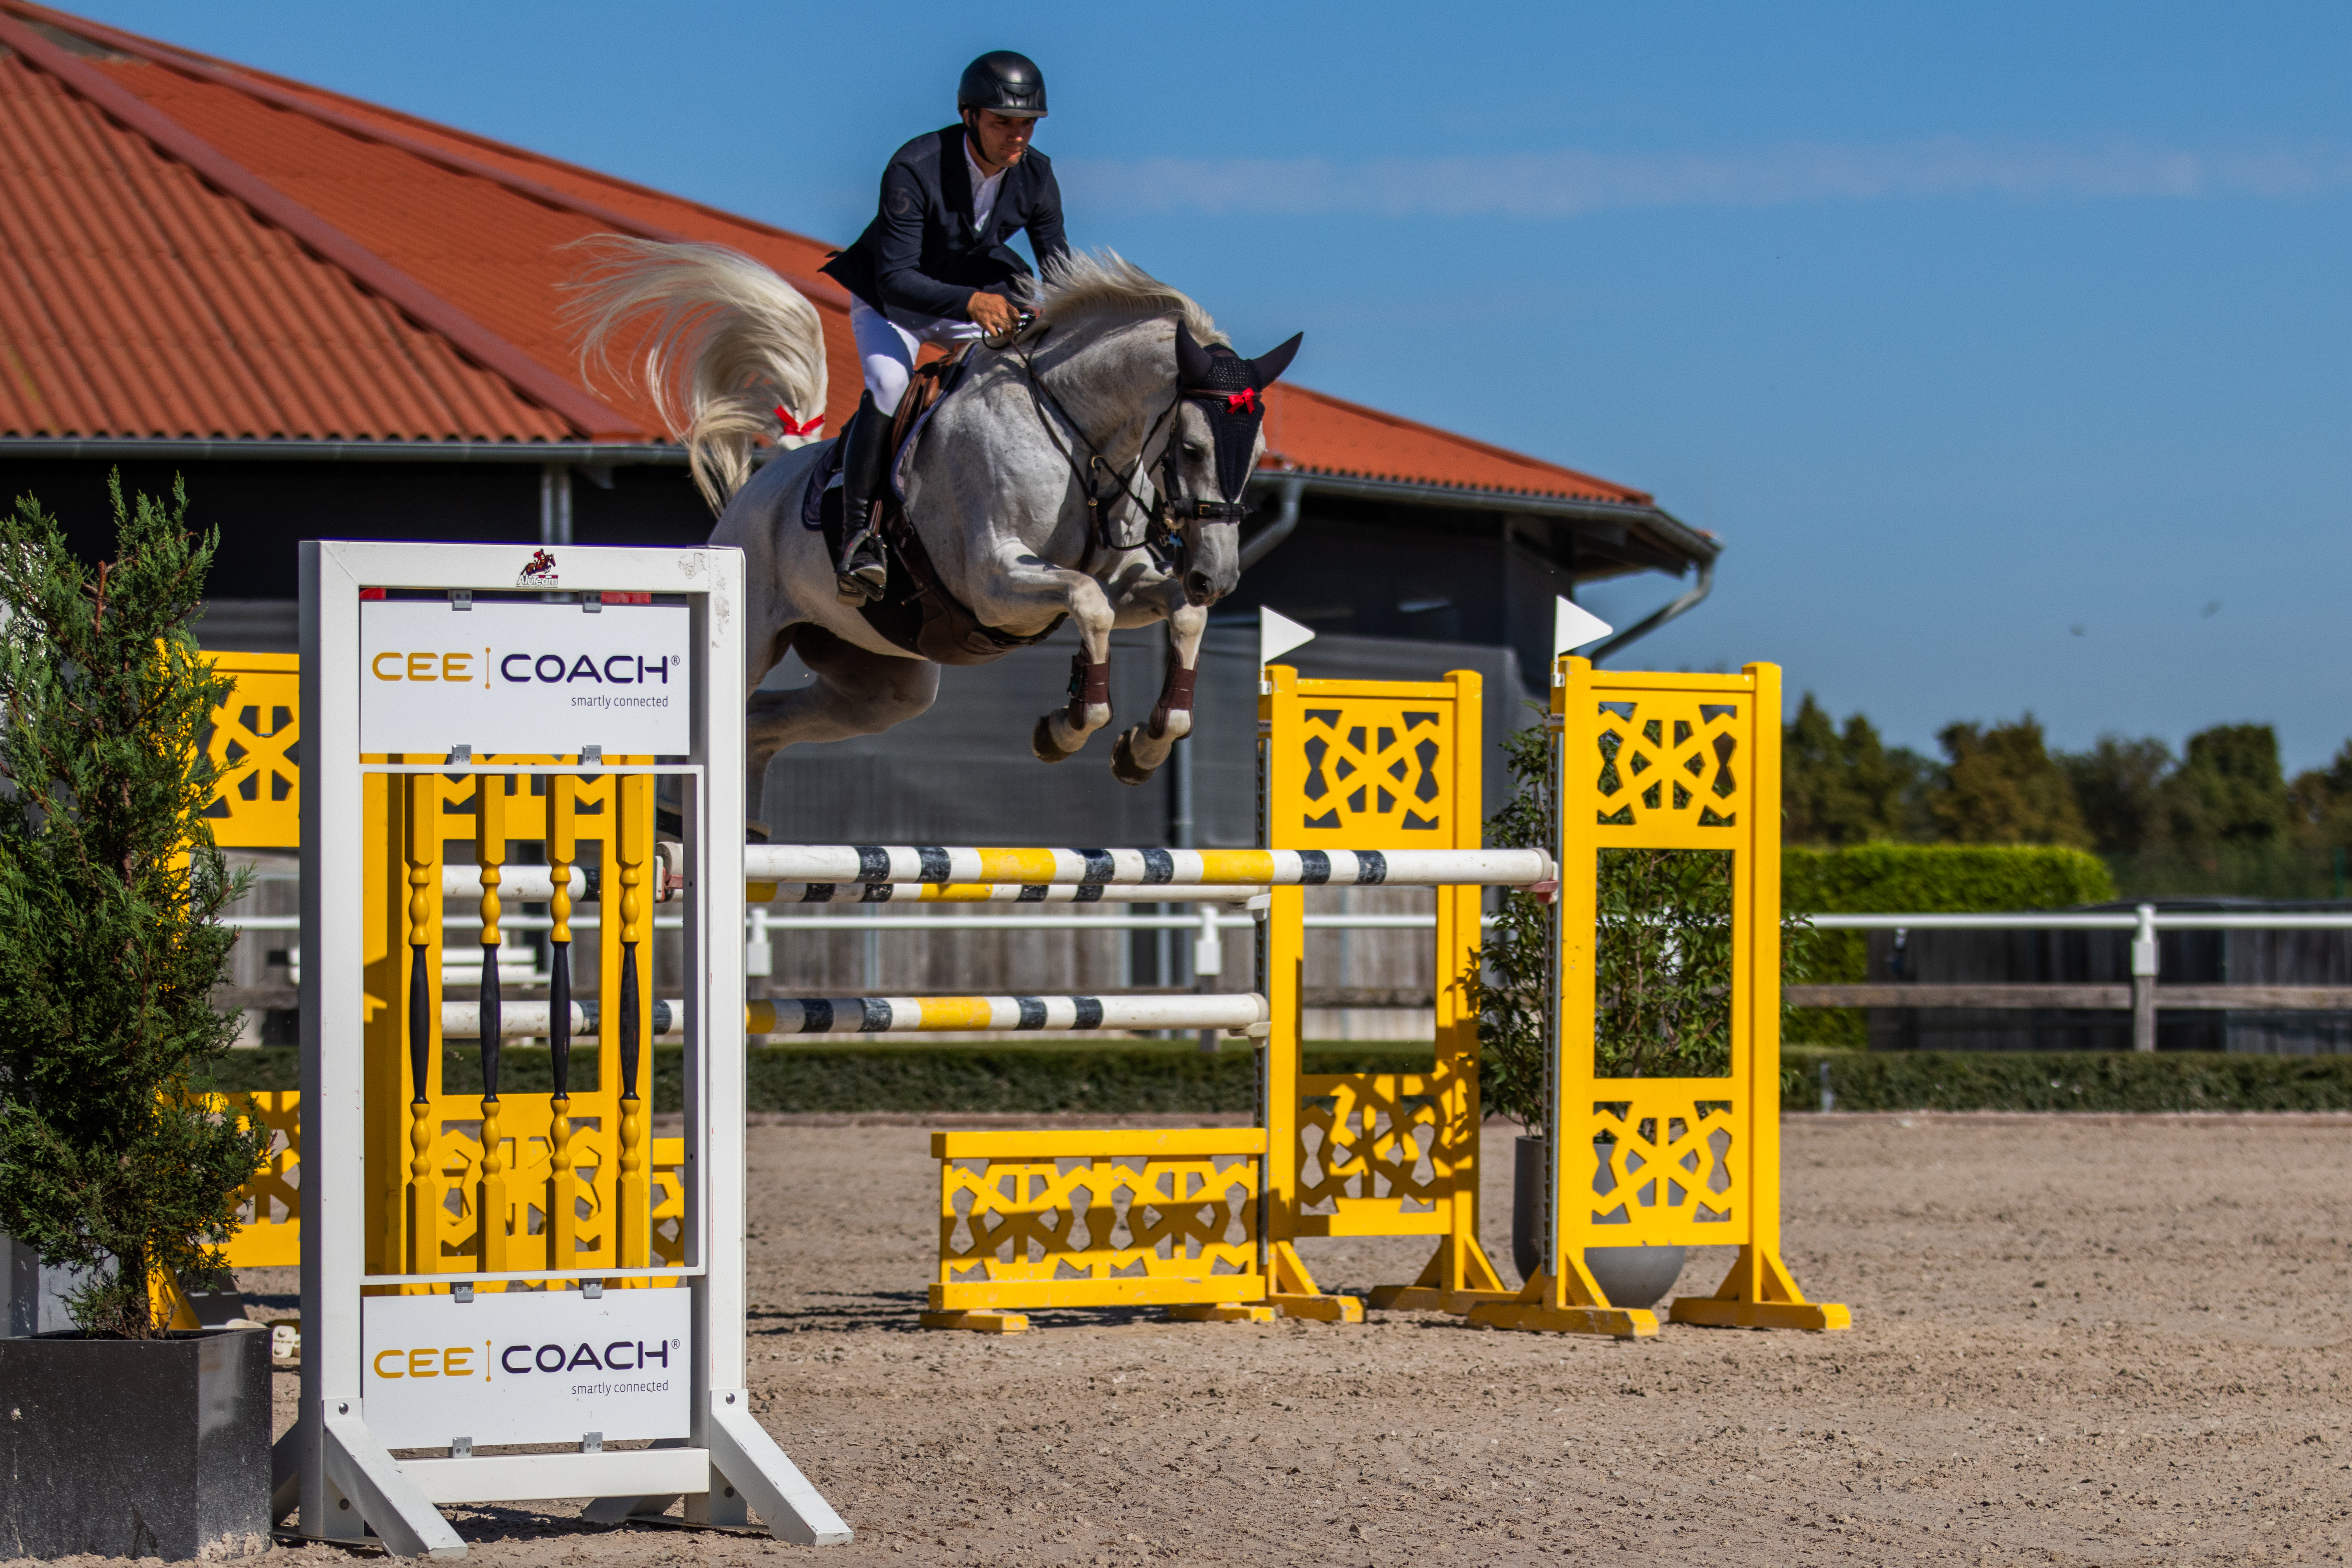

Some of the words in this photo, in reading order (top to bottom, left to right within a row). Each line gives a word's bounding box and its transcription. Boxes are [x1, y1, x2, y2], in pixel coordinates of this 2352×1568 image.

[517, 575, 559, 586] AluTeam
[372, 652, 474, 682] CEE
[572, 695, 611, 710] smartly
[613, 695, 668, 707] connected
[374, 1347, 474, 1379] CEE
[572, 1382, 612, 1396] smartly
[614, 1379, 668, 1393] connected
